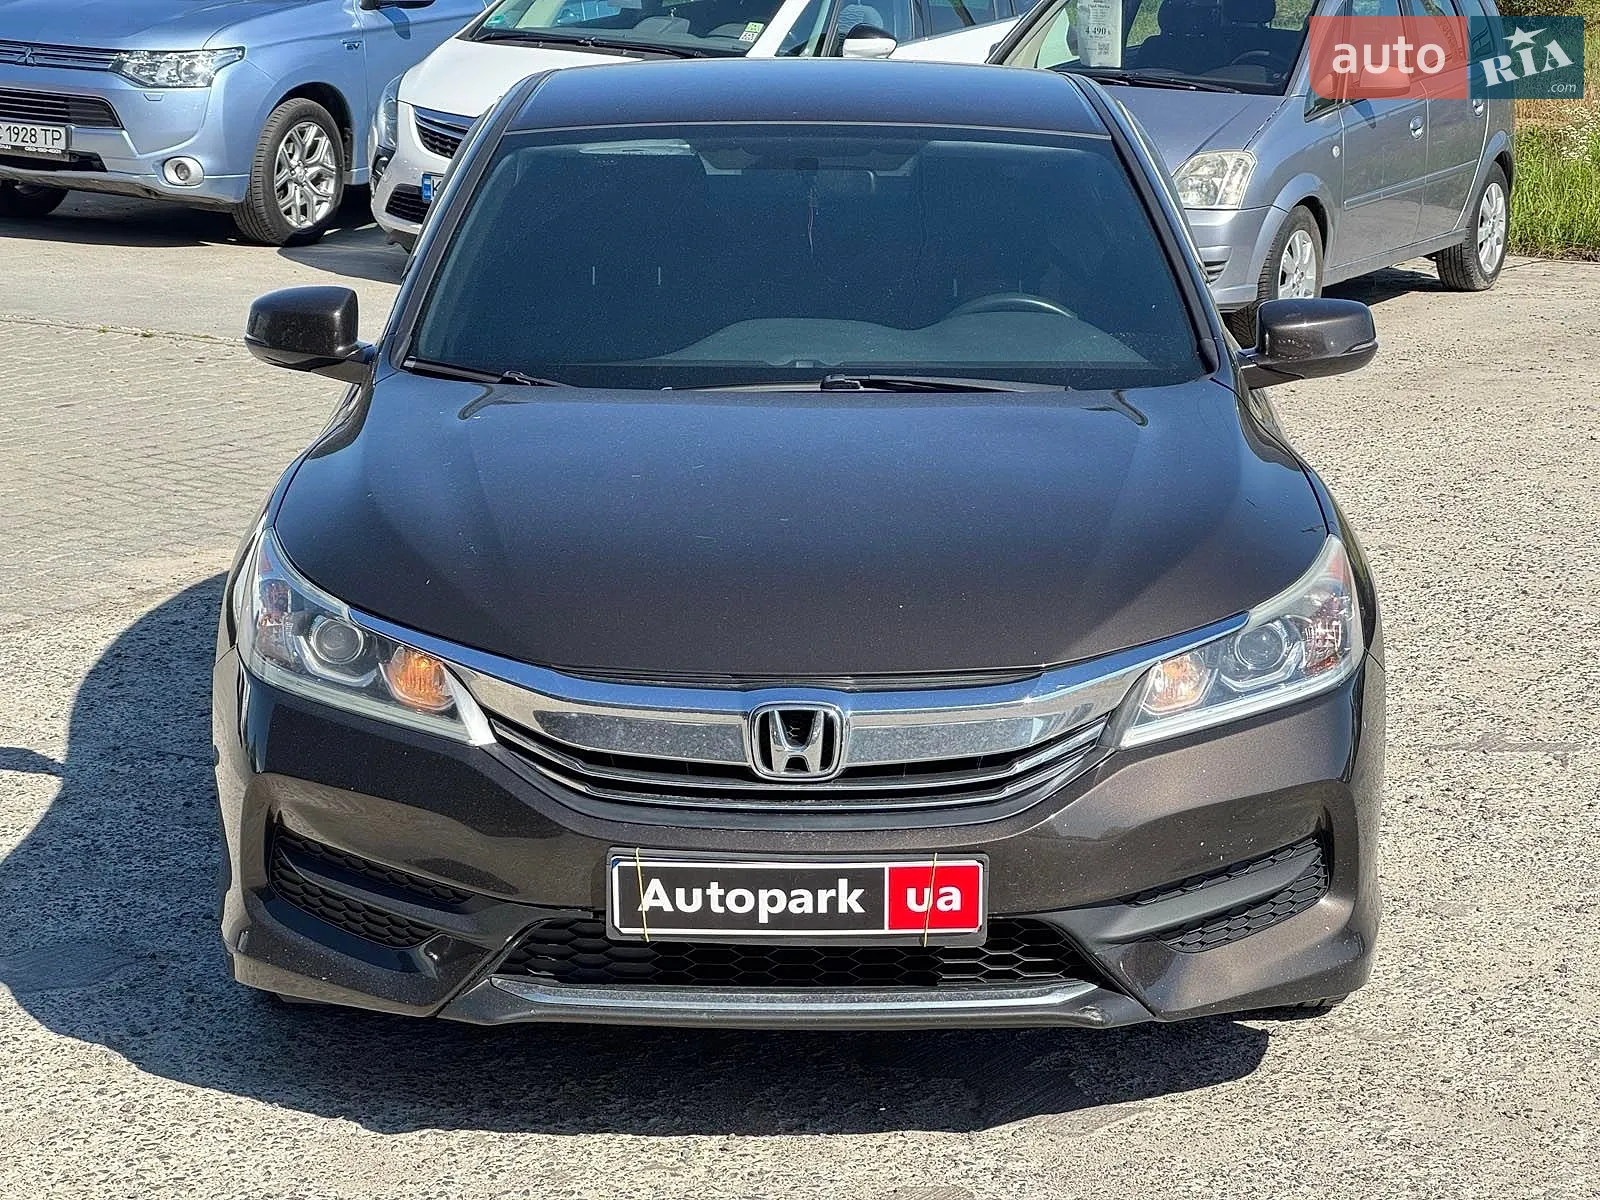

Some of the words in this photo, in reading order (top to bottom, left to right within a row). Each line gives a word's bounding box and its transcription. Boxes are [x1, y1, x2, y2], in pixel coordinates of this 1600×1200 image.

[1092, 27, 1107, 35] 490
[6, 126, 37, 144] 1928
[40, 128, 62, 146] TP
[637, 877, 865, 923] Autopark
[905, 885, 962, 912] ua
